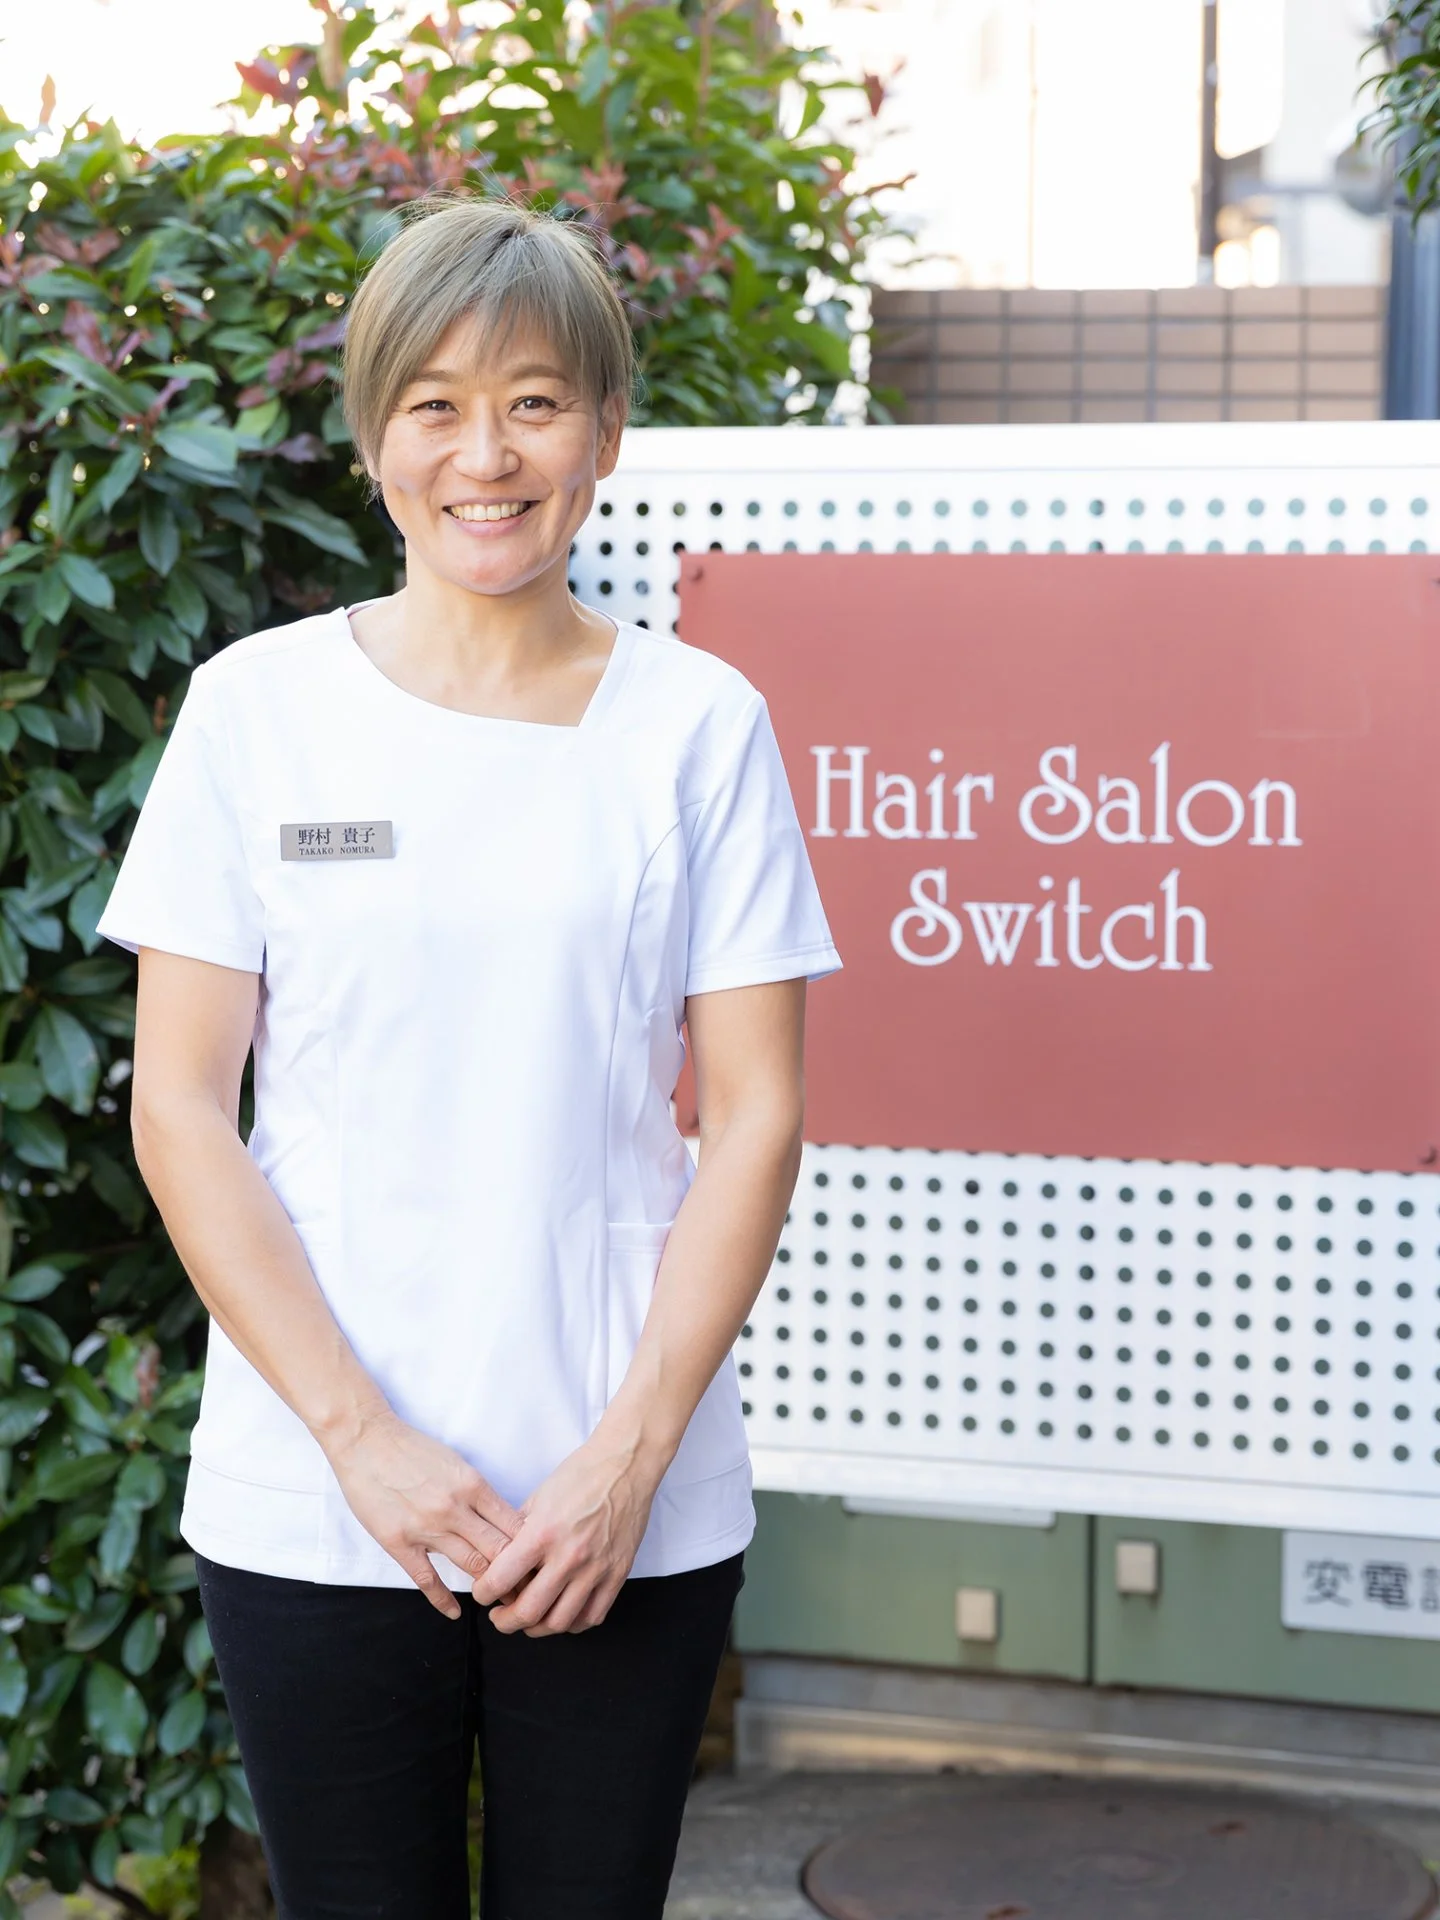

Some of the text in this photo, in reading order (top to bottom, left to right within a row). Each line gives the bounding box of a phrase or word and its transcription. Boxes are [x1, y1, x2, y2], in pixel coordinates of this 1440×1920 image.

[809, 741, 1303, 847] Hair Salon
[298, 827, 375, 845] 野村 貴子
[299, 845, 375, 856] TAKAKO NOMURA
[889, 866, 1213, 972] Switch
